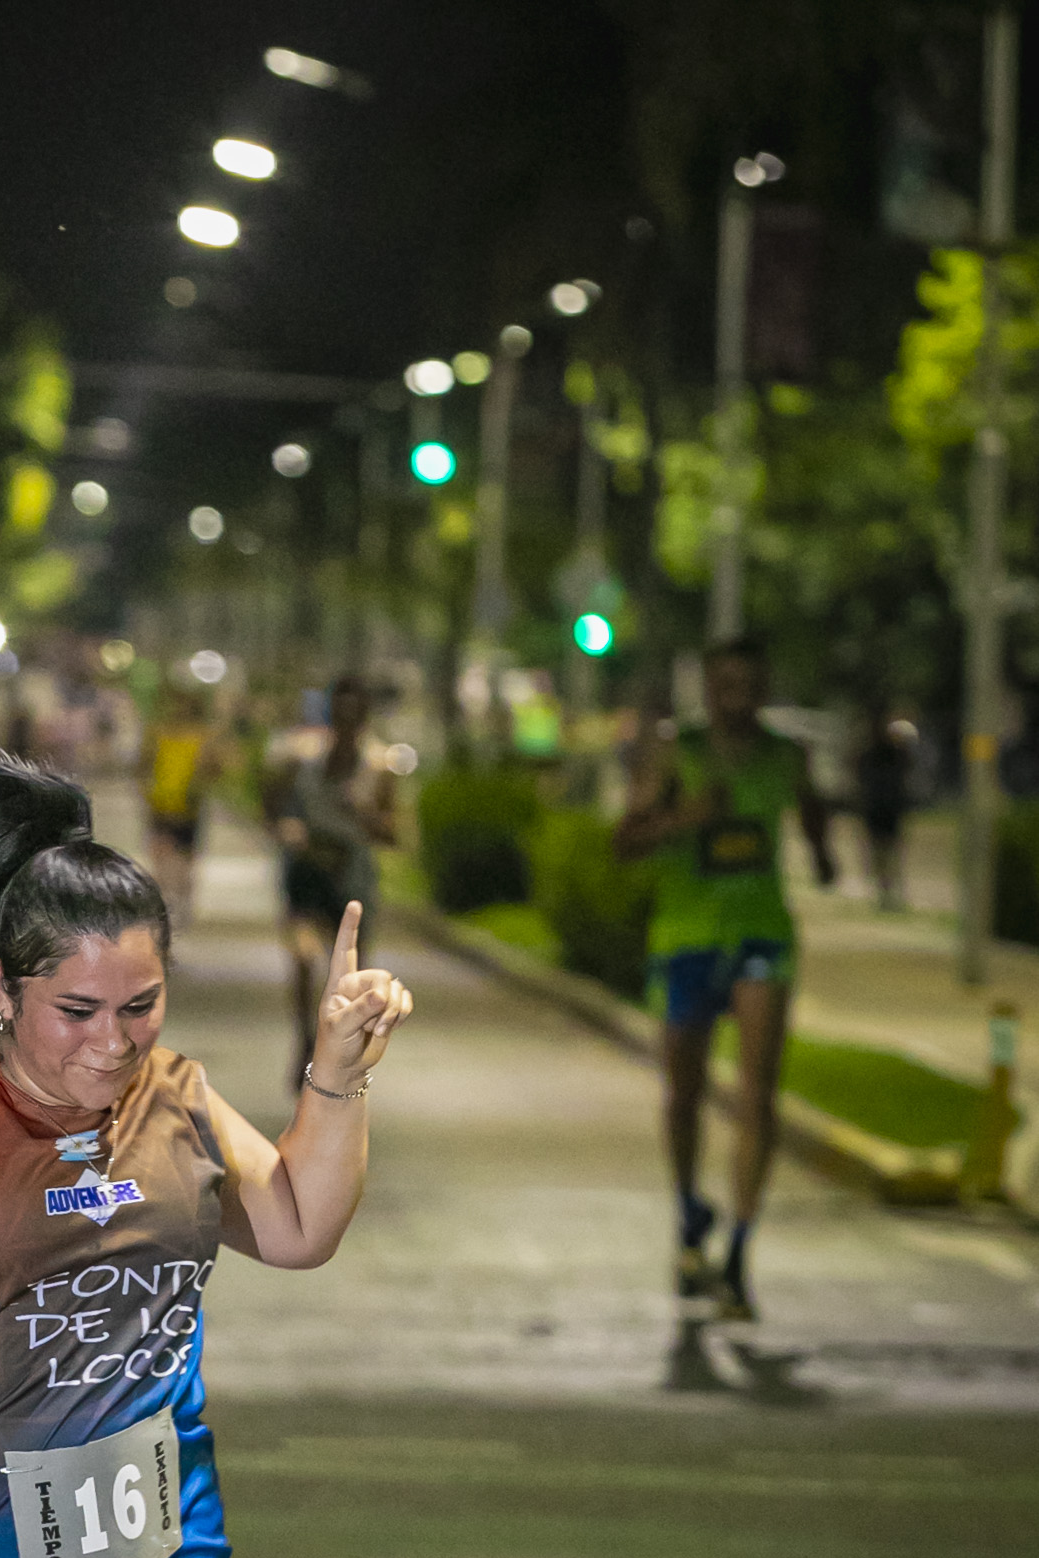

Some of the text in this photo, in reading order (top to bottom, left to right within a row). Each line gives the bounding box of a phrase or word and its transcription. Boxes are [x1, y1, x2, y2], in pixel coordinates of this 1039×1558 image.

[47, 1182, 141, 1214] ADVENTRE
[15, 1308, 111, 1349] DE
[74, 1463, 146, 1555] 16
[154, 1440, 171, 1531] EXACTO
